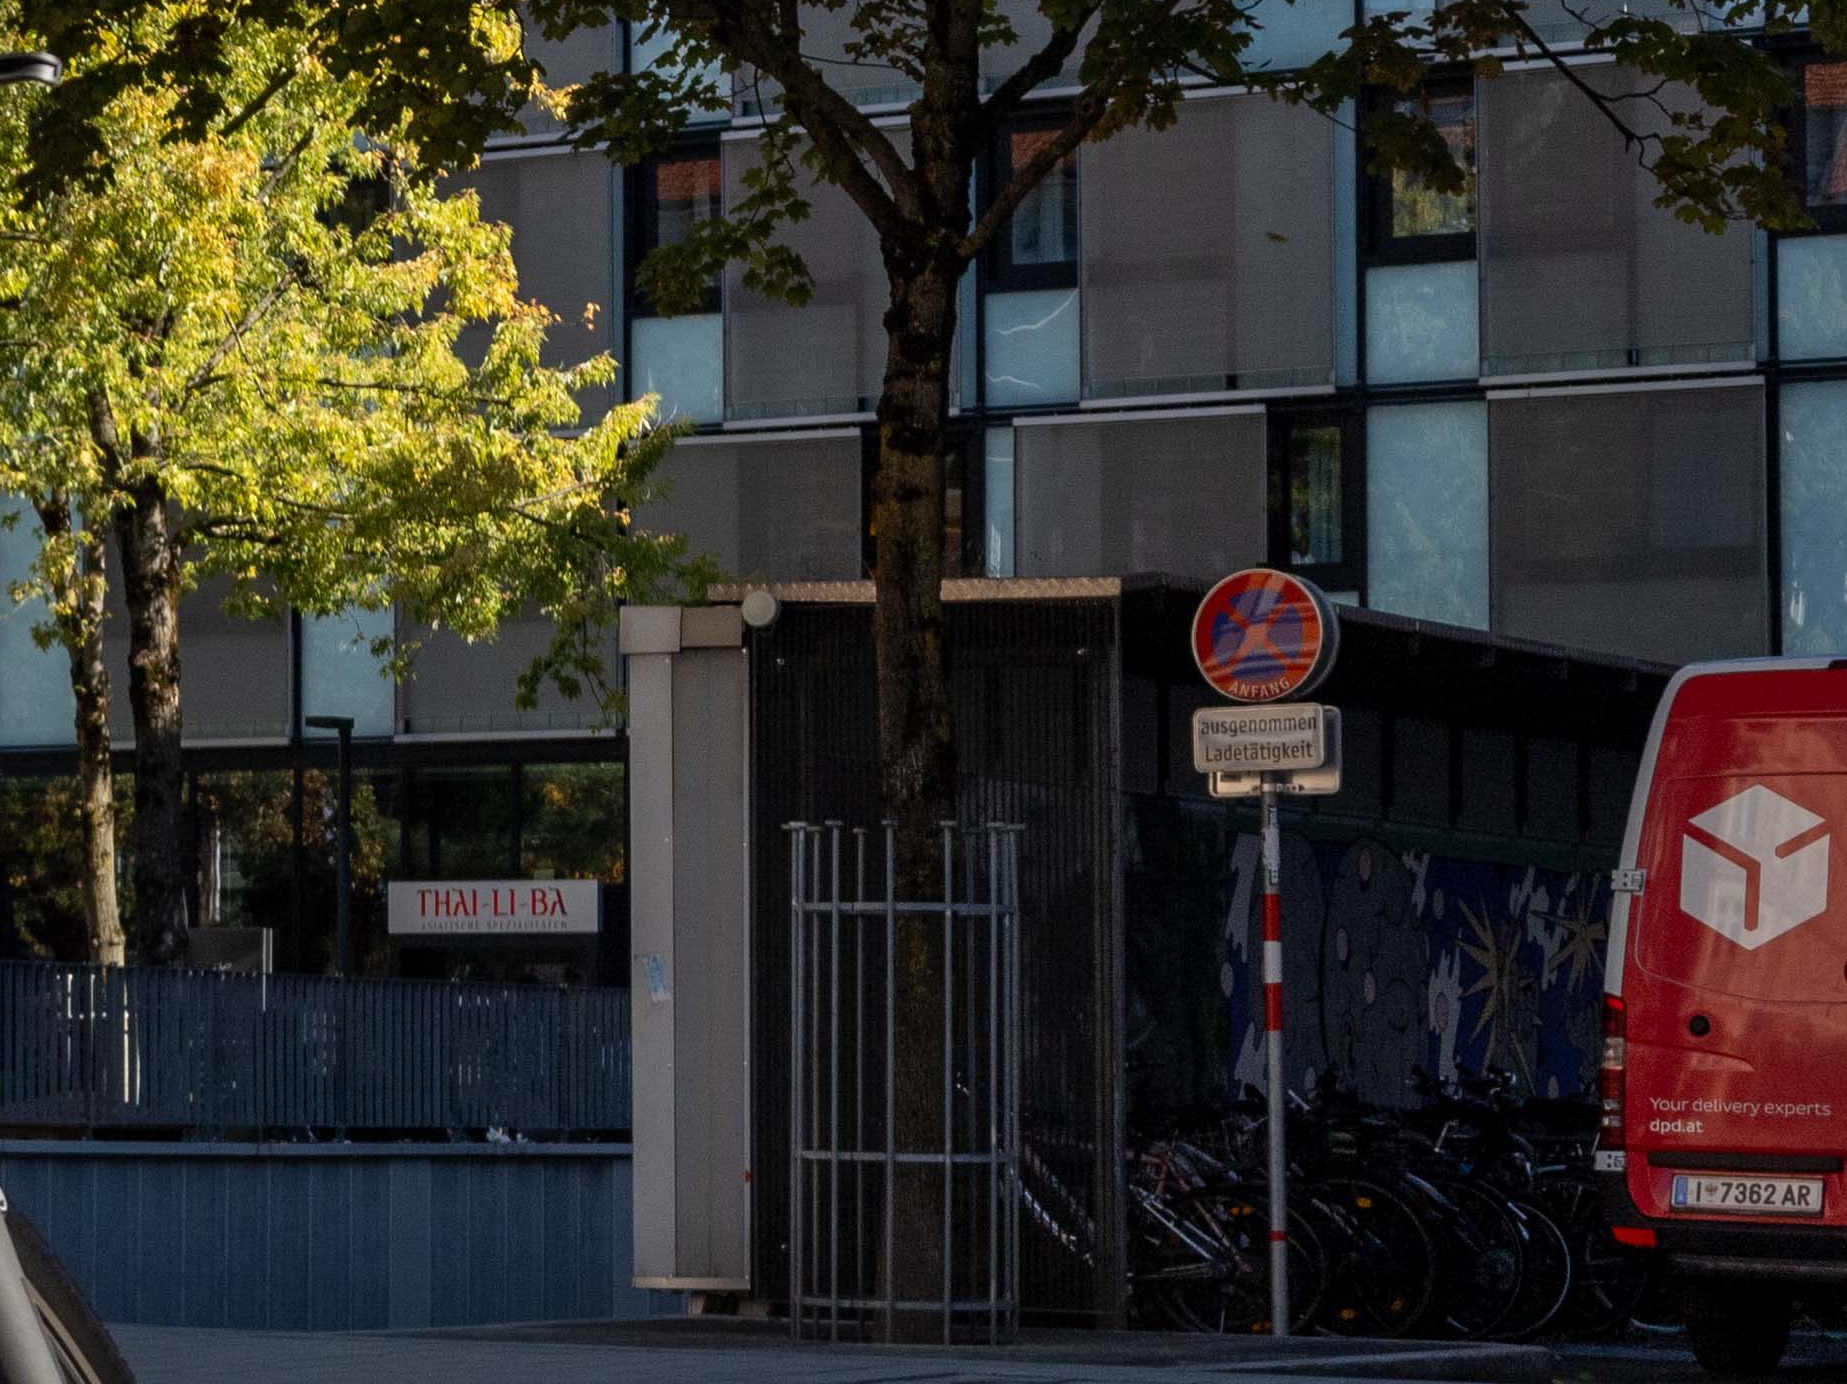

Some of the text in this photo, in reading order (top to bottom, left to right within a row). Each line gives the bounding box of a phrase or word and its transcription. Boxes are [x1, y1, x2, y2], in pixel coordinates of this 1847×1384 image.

[1228, 676, 1290, 697] ANFANG
[1201, 716, 1317, 737] ausgenommen
[1205, 740, 1313, 763] Ladetätigkeit
[1650, 1097, 1832, 1117] Your delivery experts
[1649, 1119, 1704, 1135] dpd.at
[1720, 1182, 1777, 1205] 7362
[1781, 1184, 1811, 1207] AR
